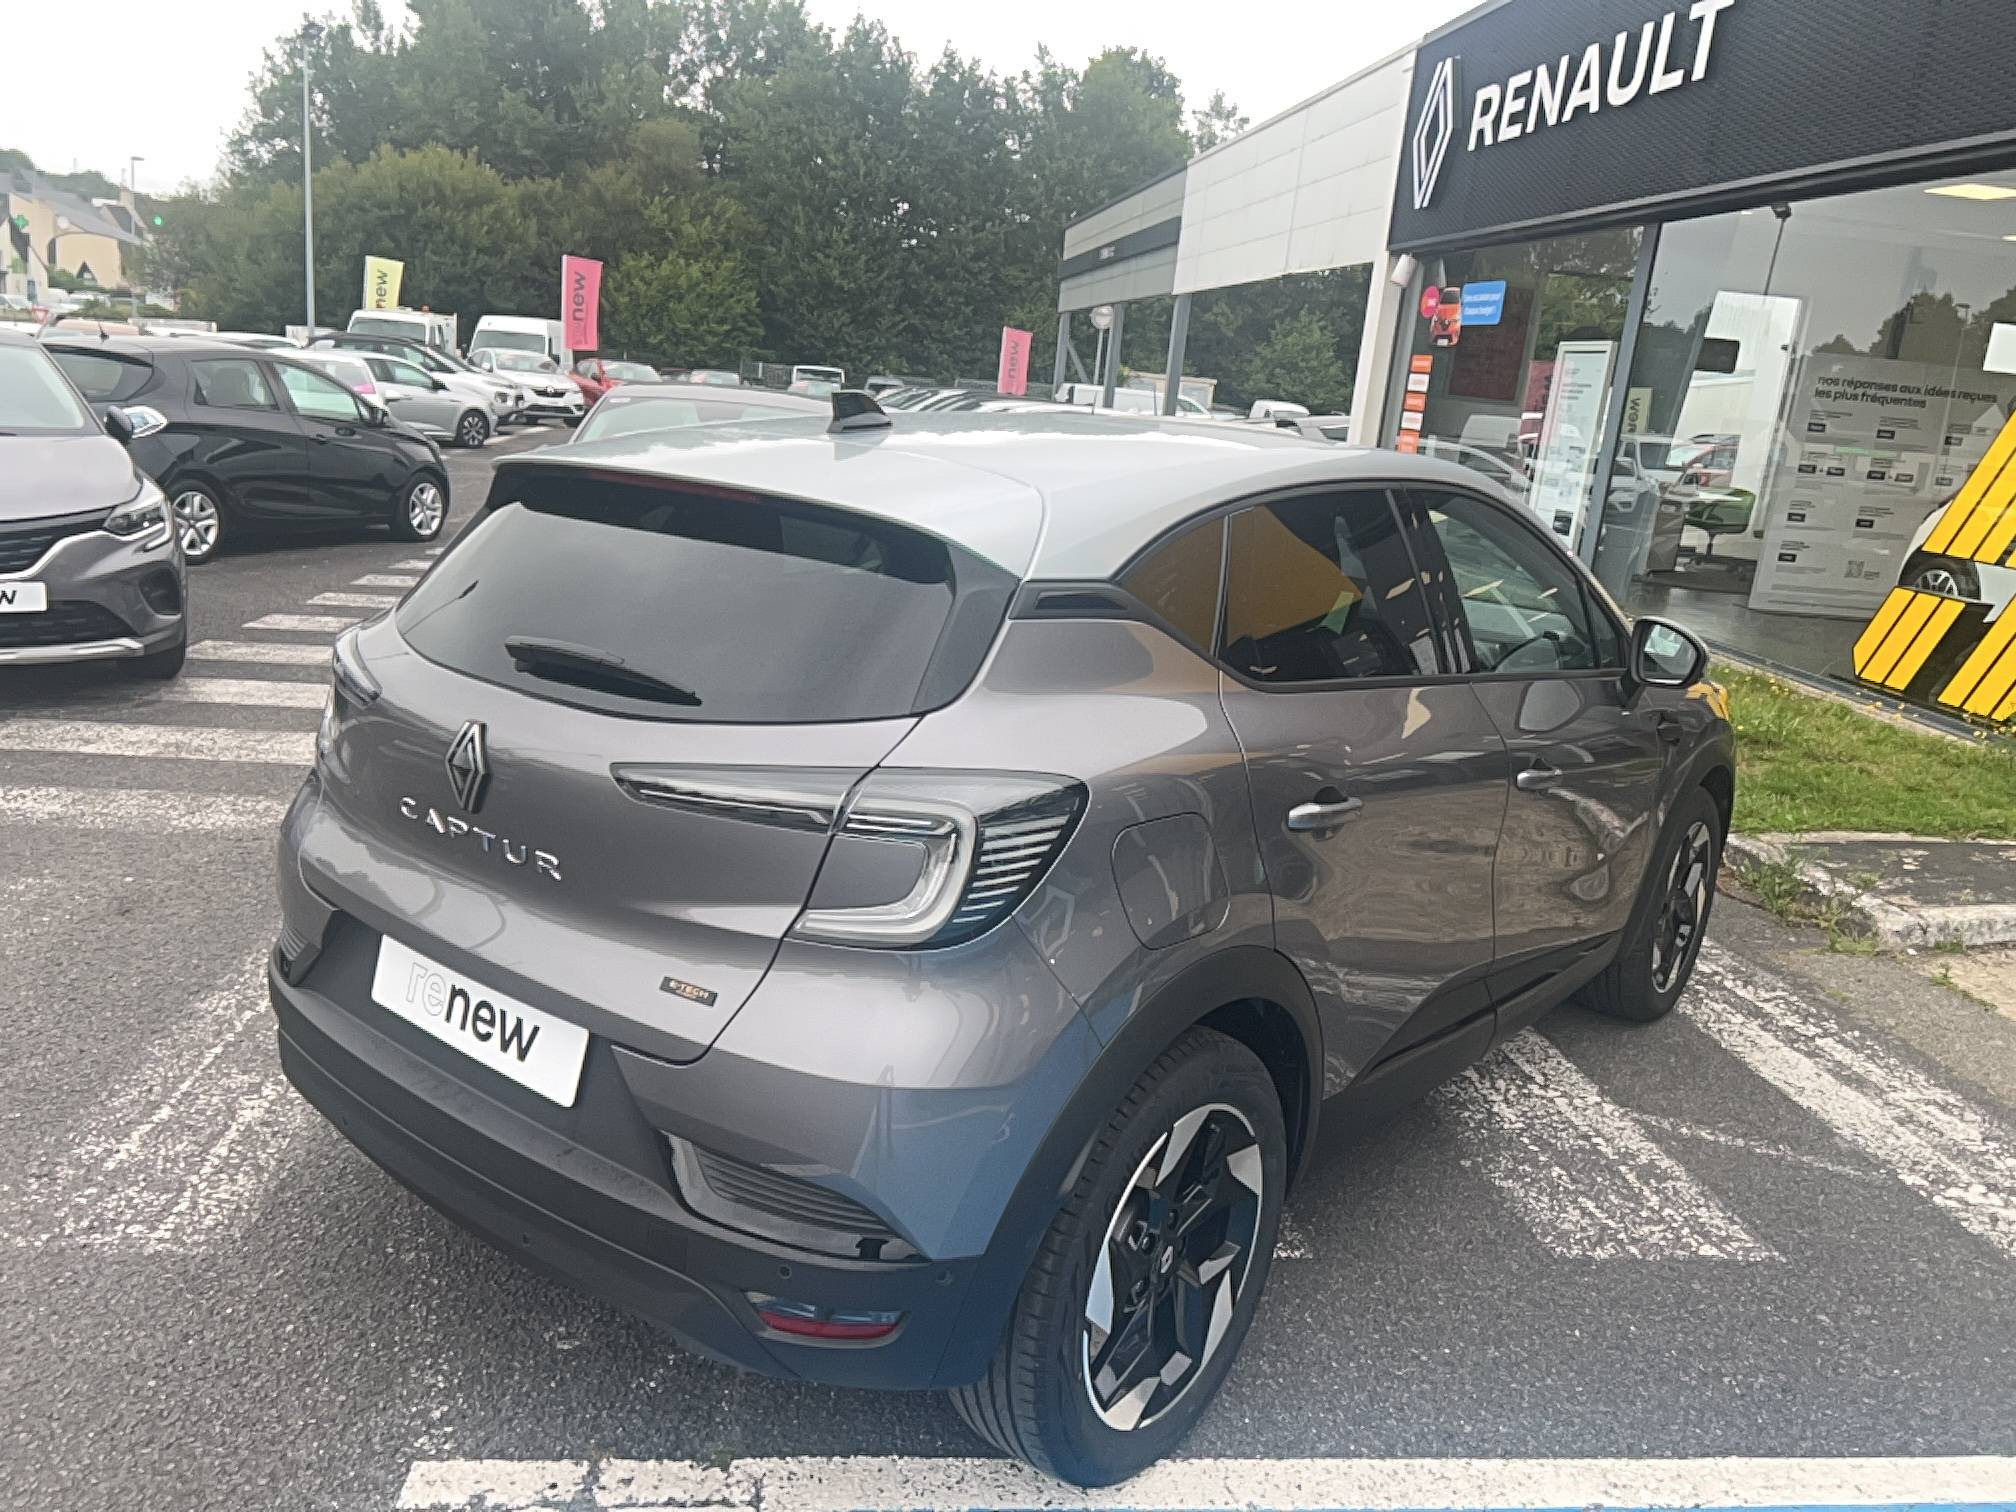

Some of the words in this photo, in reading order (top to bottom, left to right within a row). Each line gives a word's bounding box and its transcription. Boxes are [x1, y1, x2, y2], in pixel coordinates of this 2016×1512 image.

[1467, 0, 1735, 151] RENAULT
[1814, 387, 1832, 399] les
[1833, 388, 1861, 402] plus
[1861, 391, 1927, 409] fréquentes
[1818, 376, 1840, 386] nos
[1842, 377, 1898, 392] réponses
[1899, 384, 1922, 394] aux
[1924, 384, 1956, 399] idées
[1957, 389, 1998, 404] reçues
[400, 796, 561, 881] CAPTUR
[405, 961, 540, 1063] renew
